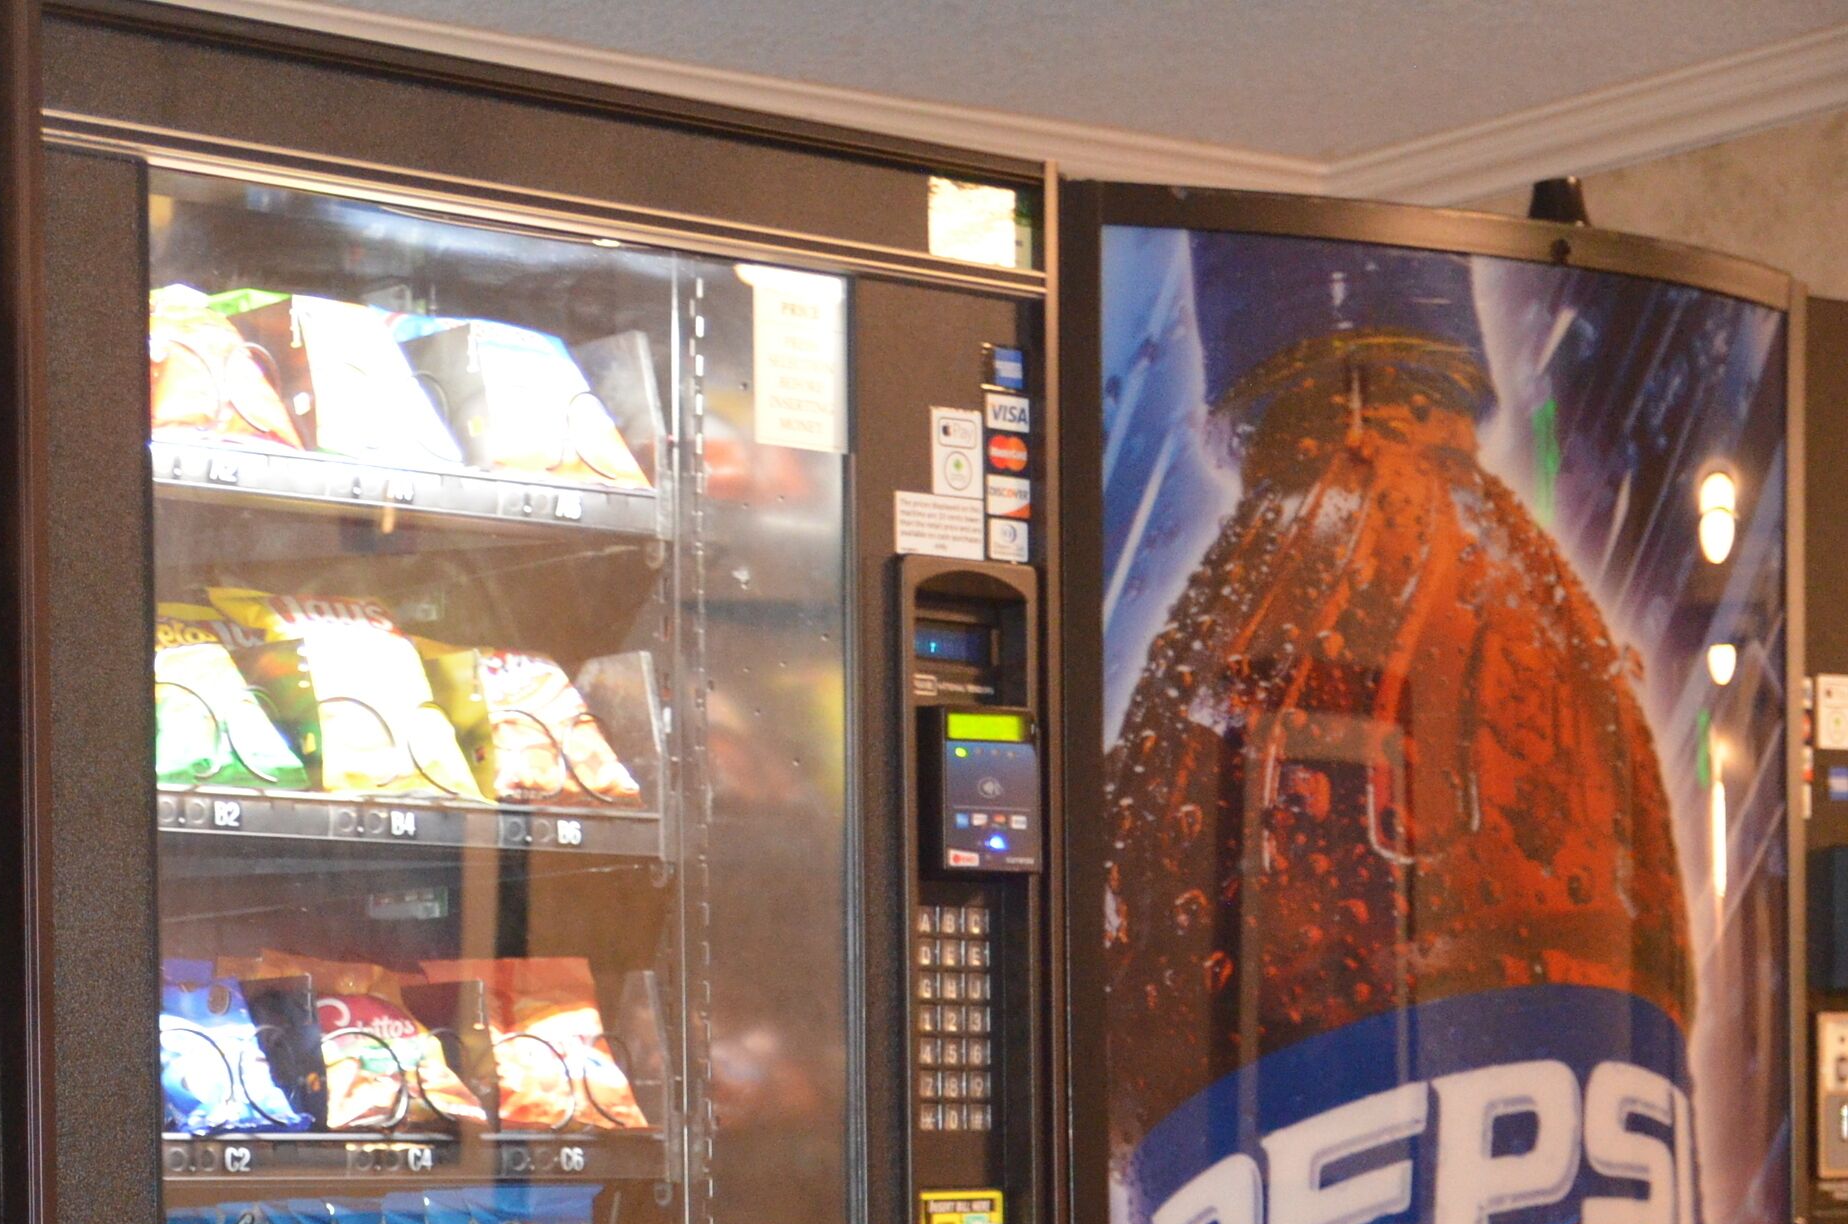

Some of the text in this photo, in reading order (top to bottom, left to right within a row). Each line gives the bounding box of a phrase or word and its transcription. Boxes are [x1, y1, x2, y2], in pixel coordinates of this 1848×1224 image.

[992, 403, 1029, 425] VISA
[988, 485, 1029, 500] DISCOVER
[214, 801, 240, 829] B2
[391, 810, 417, 838] B4
[556, 819, 583, 846] B6
[225, 1146, 251, 1173] C2
[407, 1147, 434, 1173] C4
[560, 1146, 585, 1172] C6
